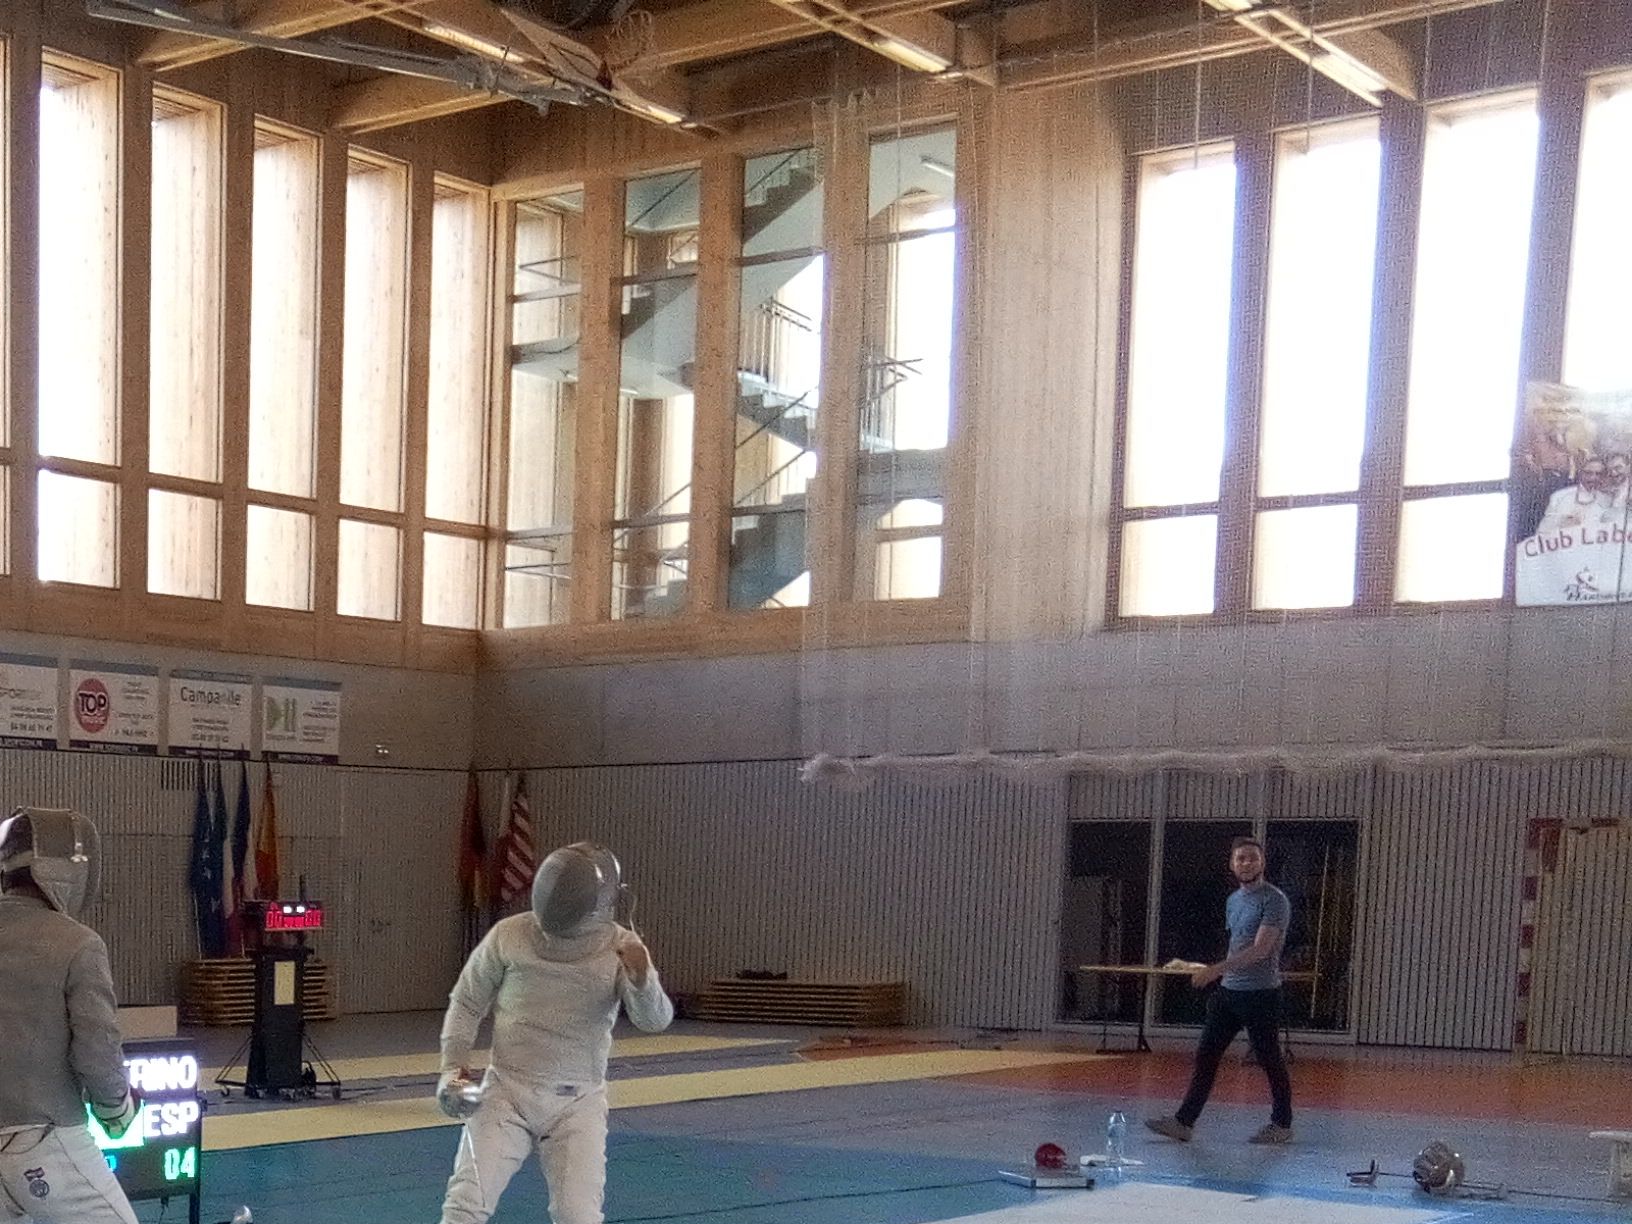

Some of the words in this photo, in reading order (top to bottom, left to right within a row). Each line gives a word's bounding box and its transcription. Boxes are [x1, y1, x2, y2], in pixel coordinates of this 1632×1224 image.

[1524, 531, 1572, 558] Club
[78, 692, 107, 713] TOP
[143, 1100, 199, 1138] ESP
[163, 1147, 196, 1181] 04
